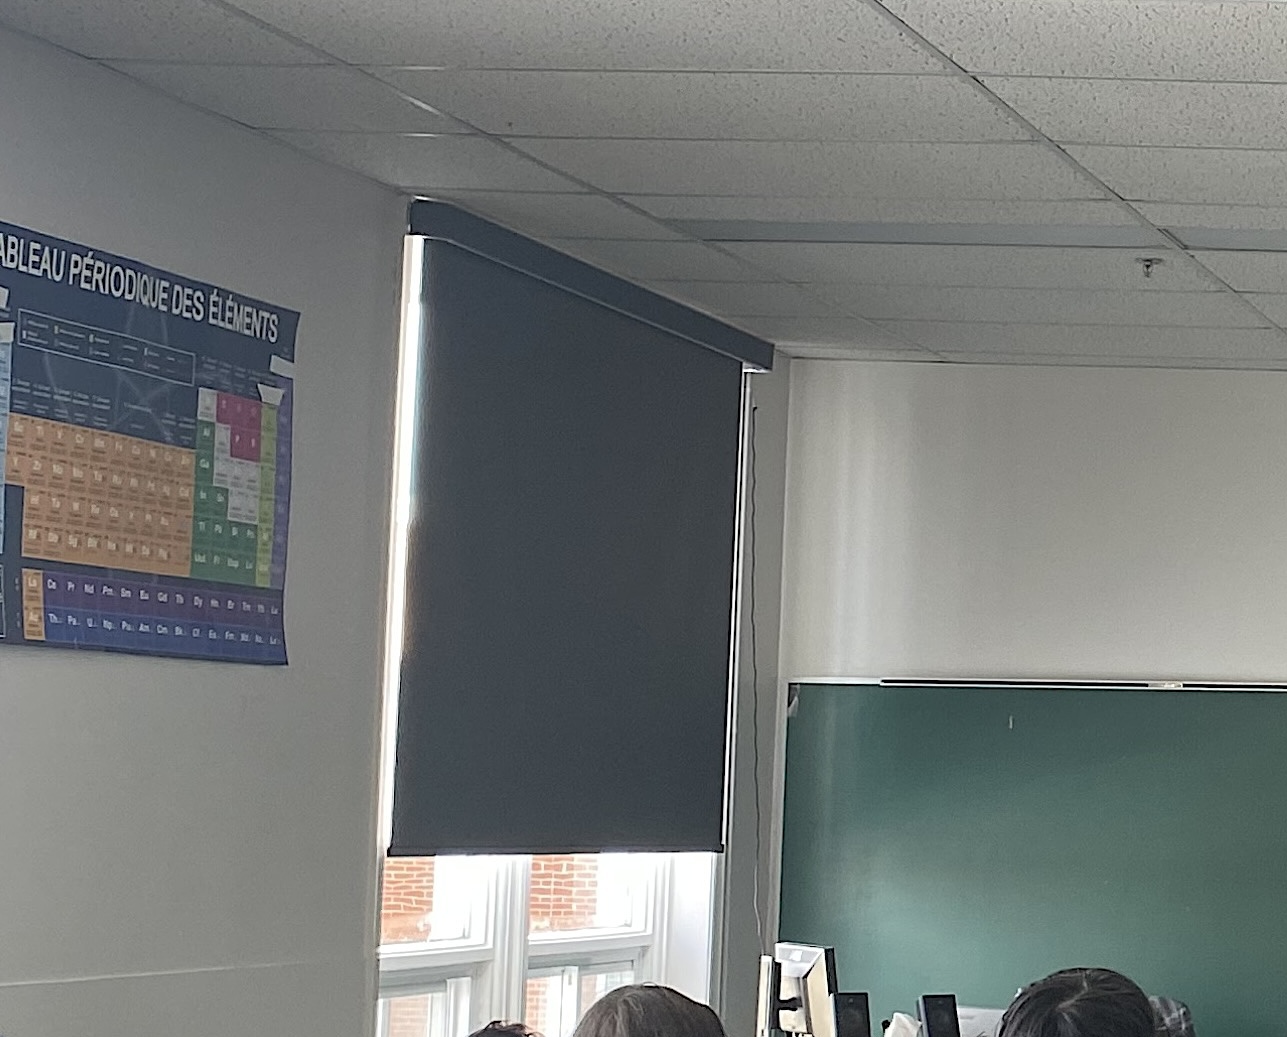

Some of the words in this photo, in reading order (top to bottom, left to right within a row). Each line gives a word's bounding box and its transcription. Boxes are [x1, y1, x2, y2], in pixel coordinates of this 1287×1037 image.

[69, 251, 170, 312] PÉRIODIQUE
[171, 284, 205, 321] DES
[208, 288, 279, 343] ÉLÉMENTS
